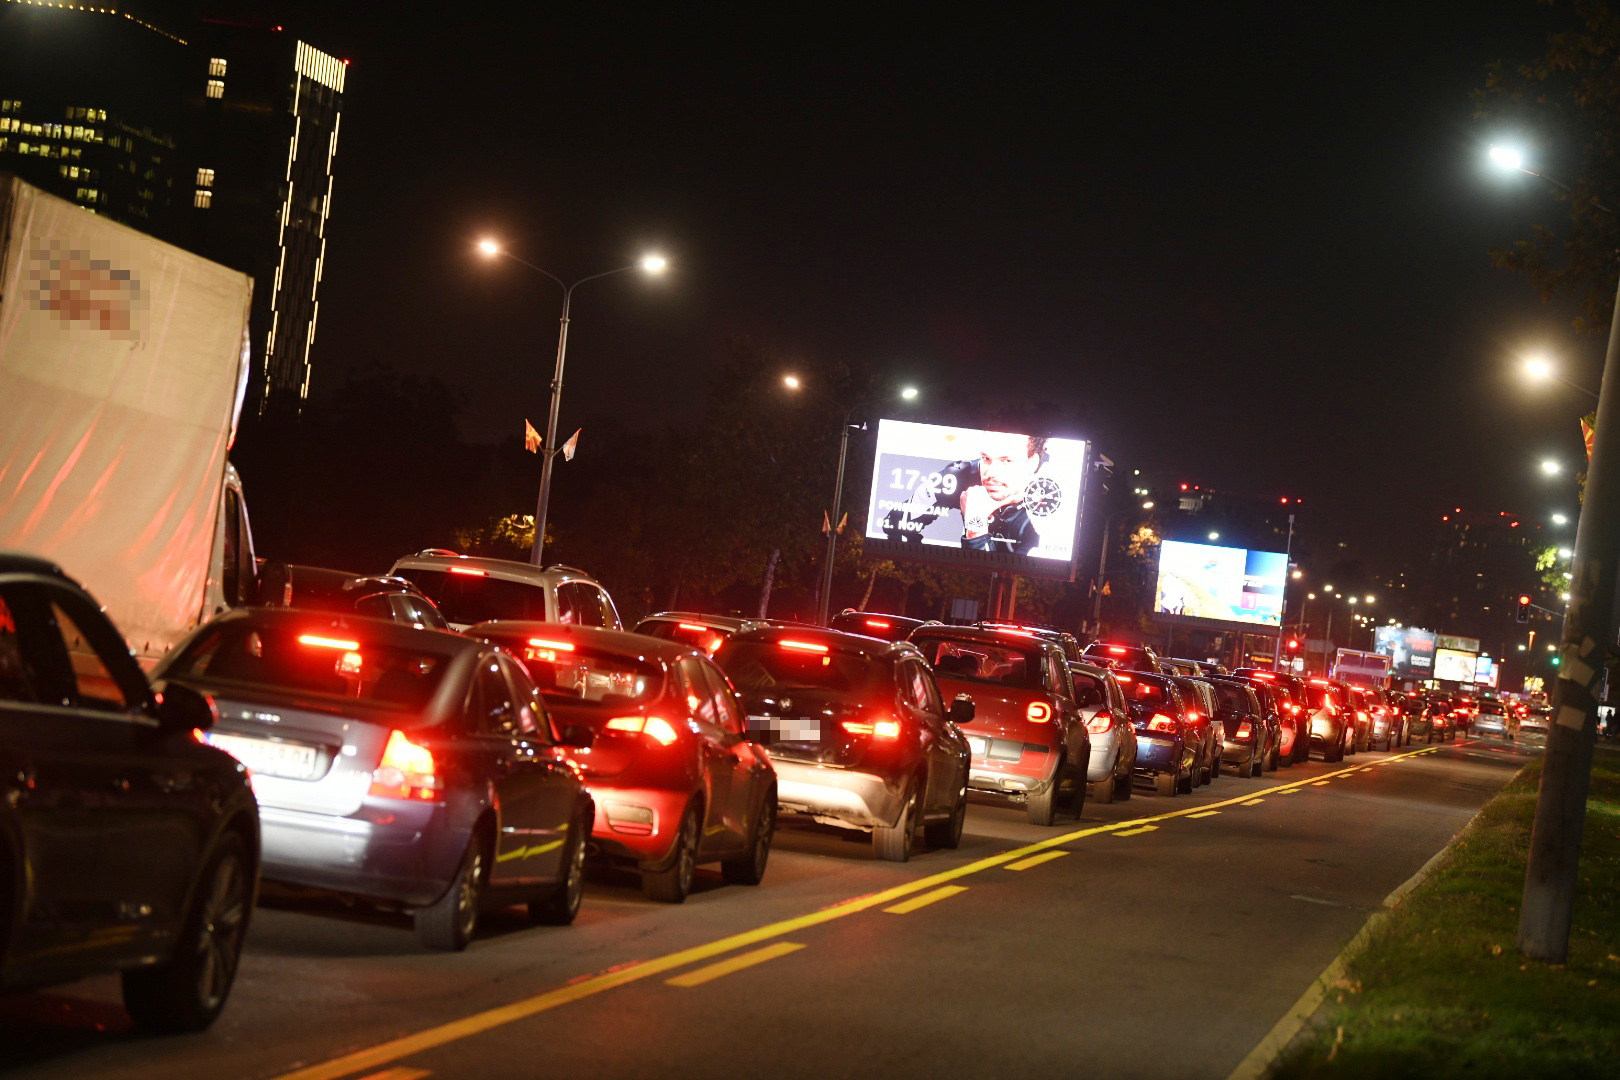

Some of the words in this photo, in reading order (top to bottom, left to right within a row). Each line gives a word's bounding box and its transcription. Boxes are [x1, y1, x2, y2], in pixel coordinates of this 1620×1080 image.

[889, 468, 958, 496] 17:29
[879, 500, 950, 517] PONJAK
[898, 520, 924, 532] NOV
